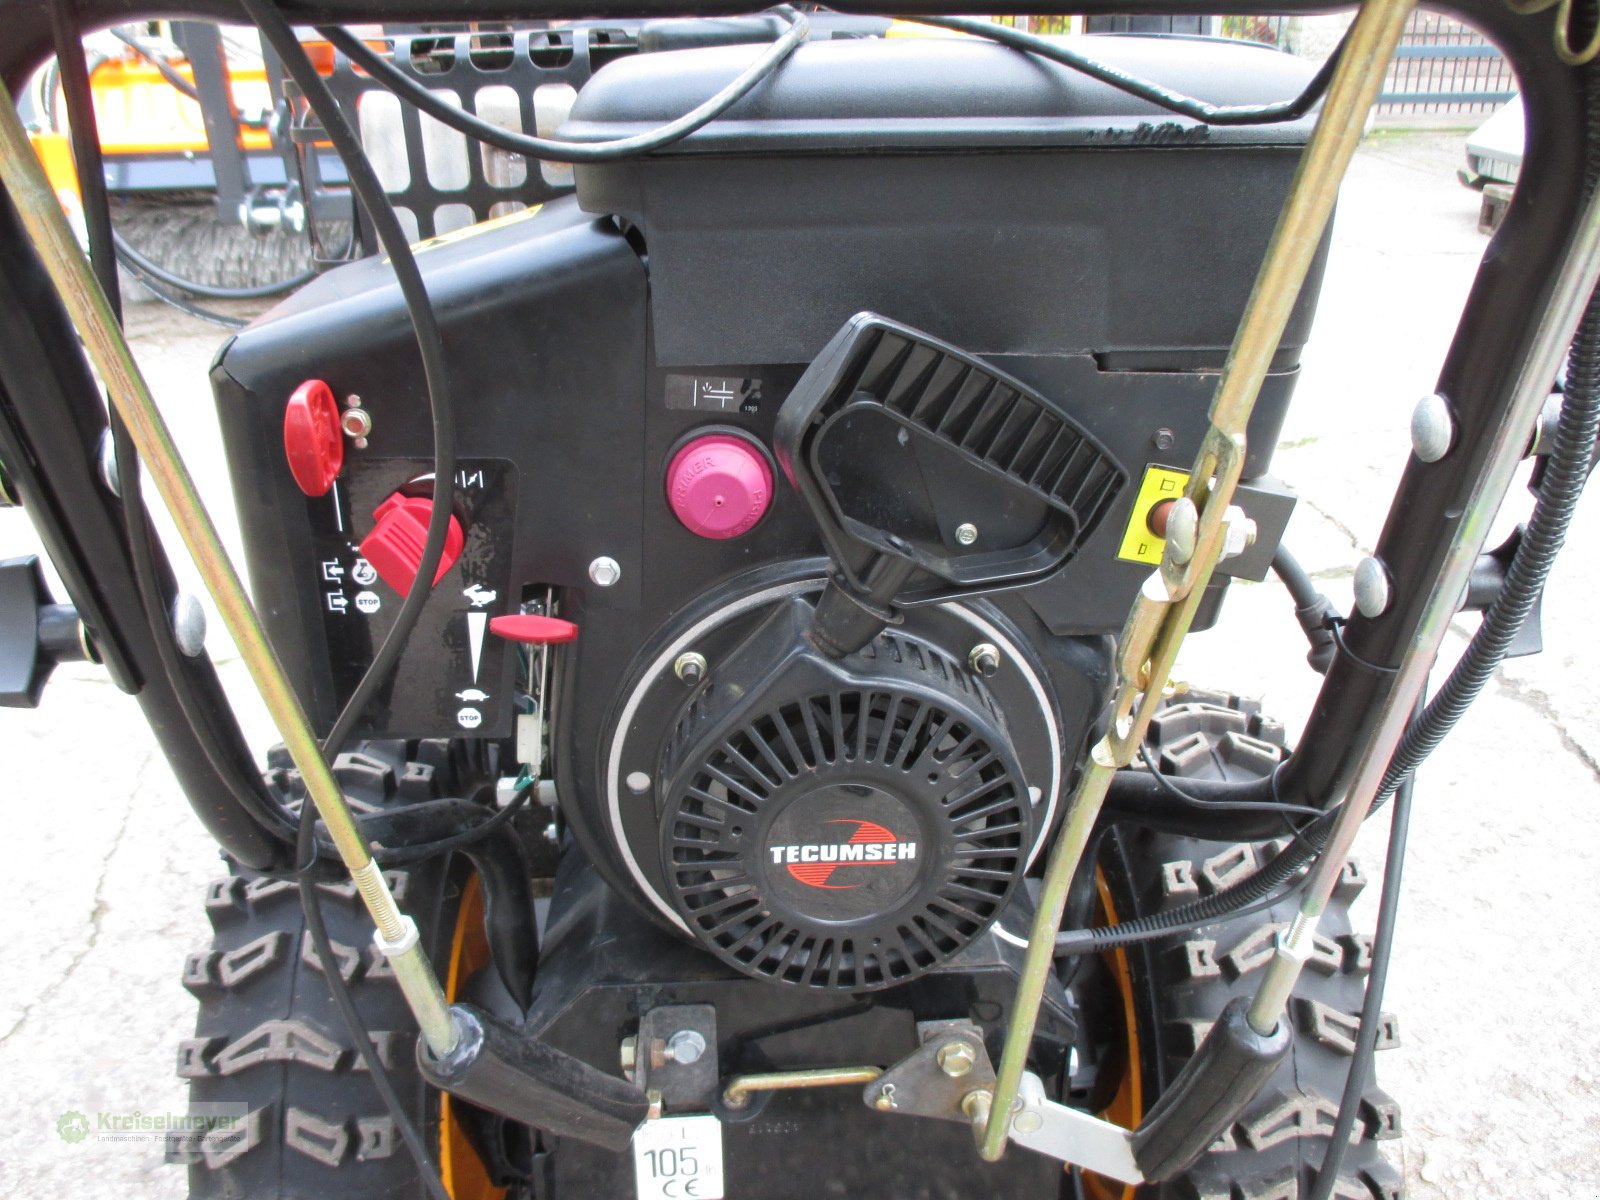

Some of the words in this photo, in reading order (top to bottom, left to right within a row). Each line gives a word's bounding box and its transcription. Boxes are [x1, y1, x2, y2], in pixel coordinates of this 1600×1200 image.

[770, 842, 916, 864] TECUMSEH
[643, 1146, 699, 1179] 105
[662, 1177, 700, 1199] CE
